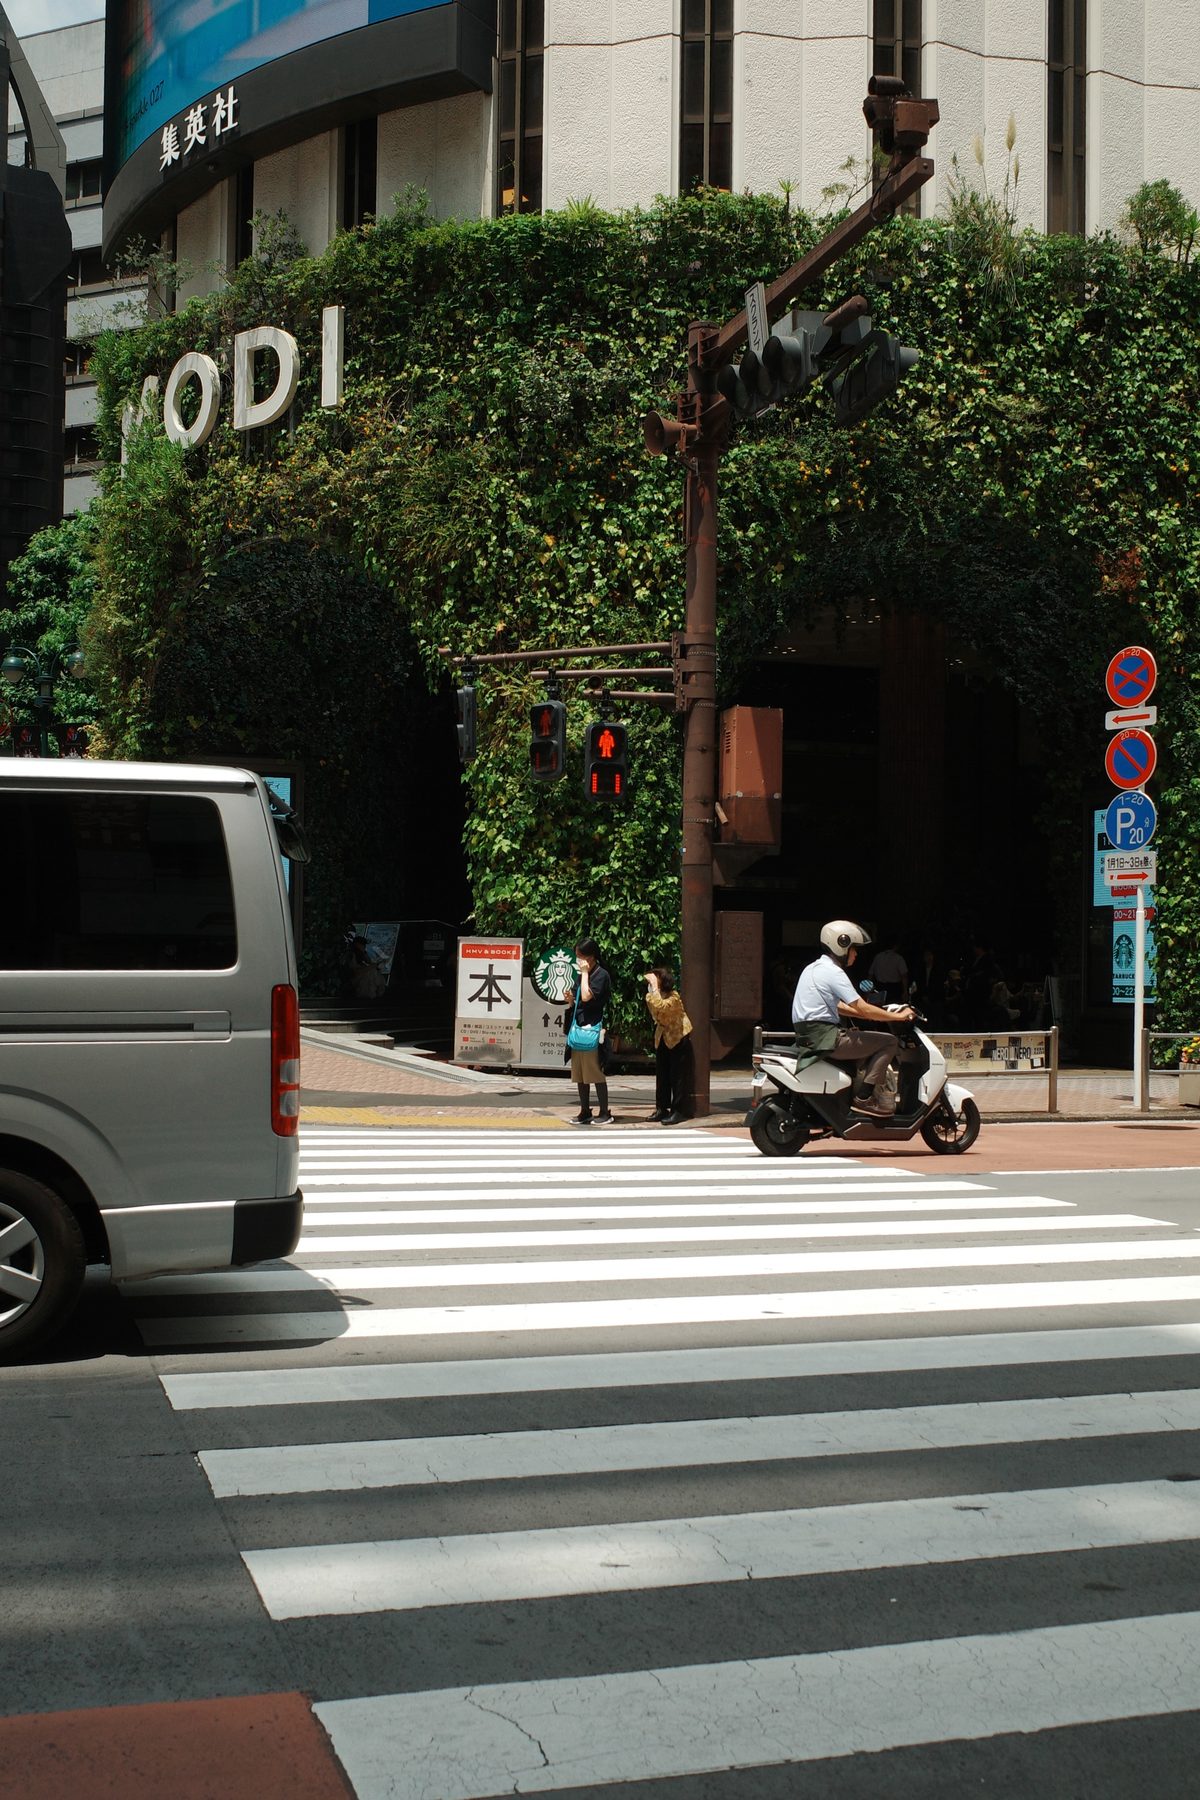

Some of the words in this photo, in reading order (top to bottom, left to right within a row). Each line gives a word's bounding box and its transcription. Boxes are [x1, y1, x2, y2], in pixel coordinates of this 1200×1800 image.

[150, 80, 164, 106] 027
[159, 85, 239, 172] 集英社
[1121, 648, 1141, 659] 7-20
[1119, 731, 1140, 741] 20-7
[1118, 794, 1144, 806] 7-20
[1116, 808, 1136, 845] P
[1129, 827, 1144, 845] 20
[1144, 816, 1150, 828] 分
[467, 964, 512, 1012] 本
[554, 1014, 564, 1028] 4
